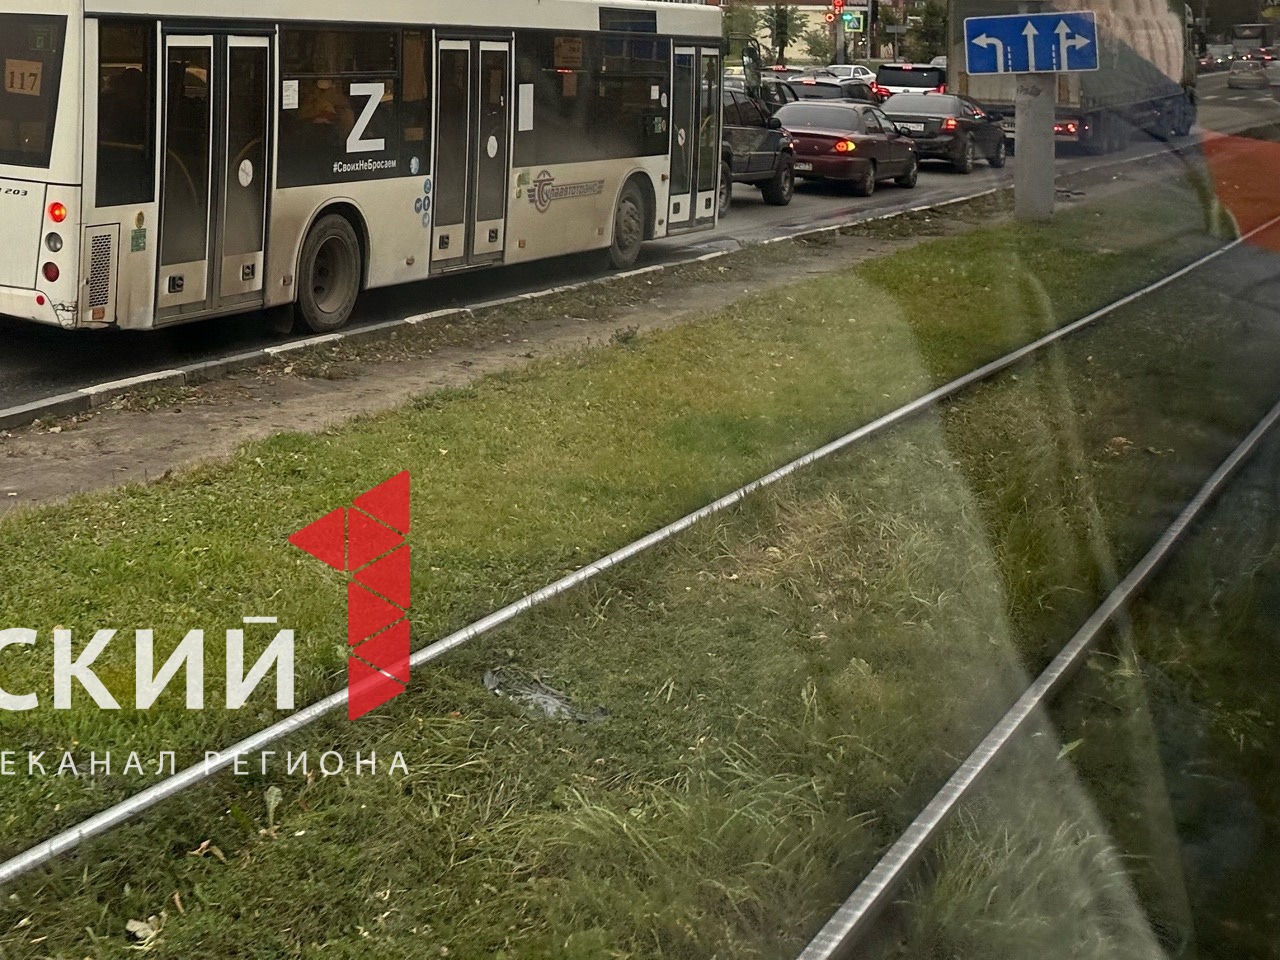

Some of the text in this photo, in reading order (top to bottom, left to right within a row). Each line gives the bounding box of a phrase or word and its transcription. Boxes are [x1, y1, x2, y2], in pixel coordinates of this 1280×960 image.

[8, 71, 38, 91] 117
[346, 83, 385, 153] Z
[332, 158, 397, 174] #СвоихНеБросаем
[4, 188, 28, 197] 203
